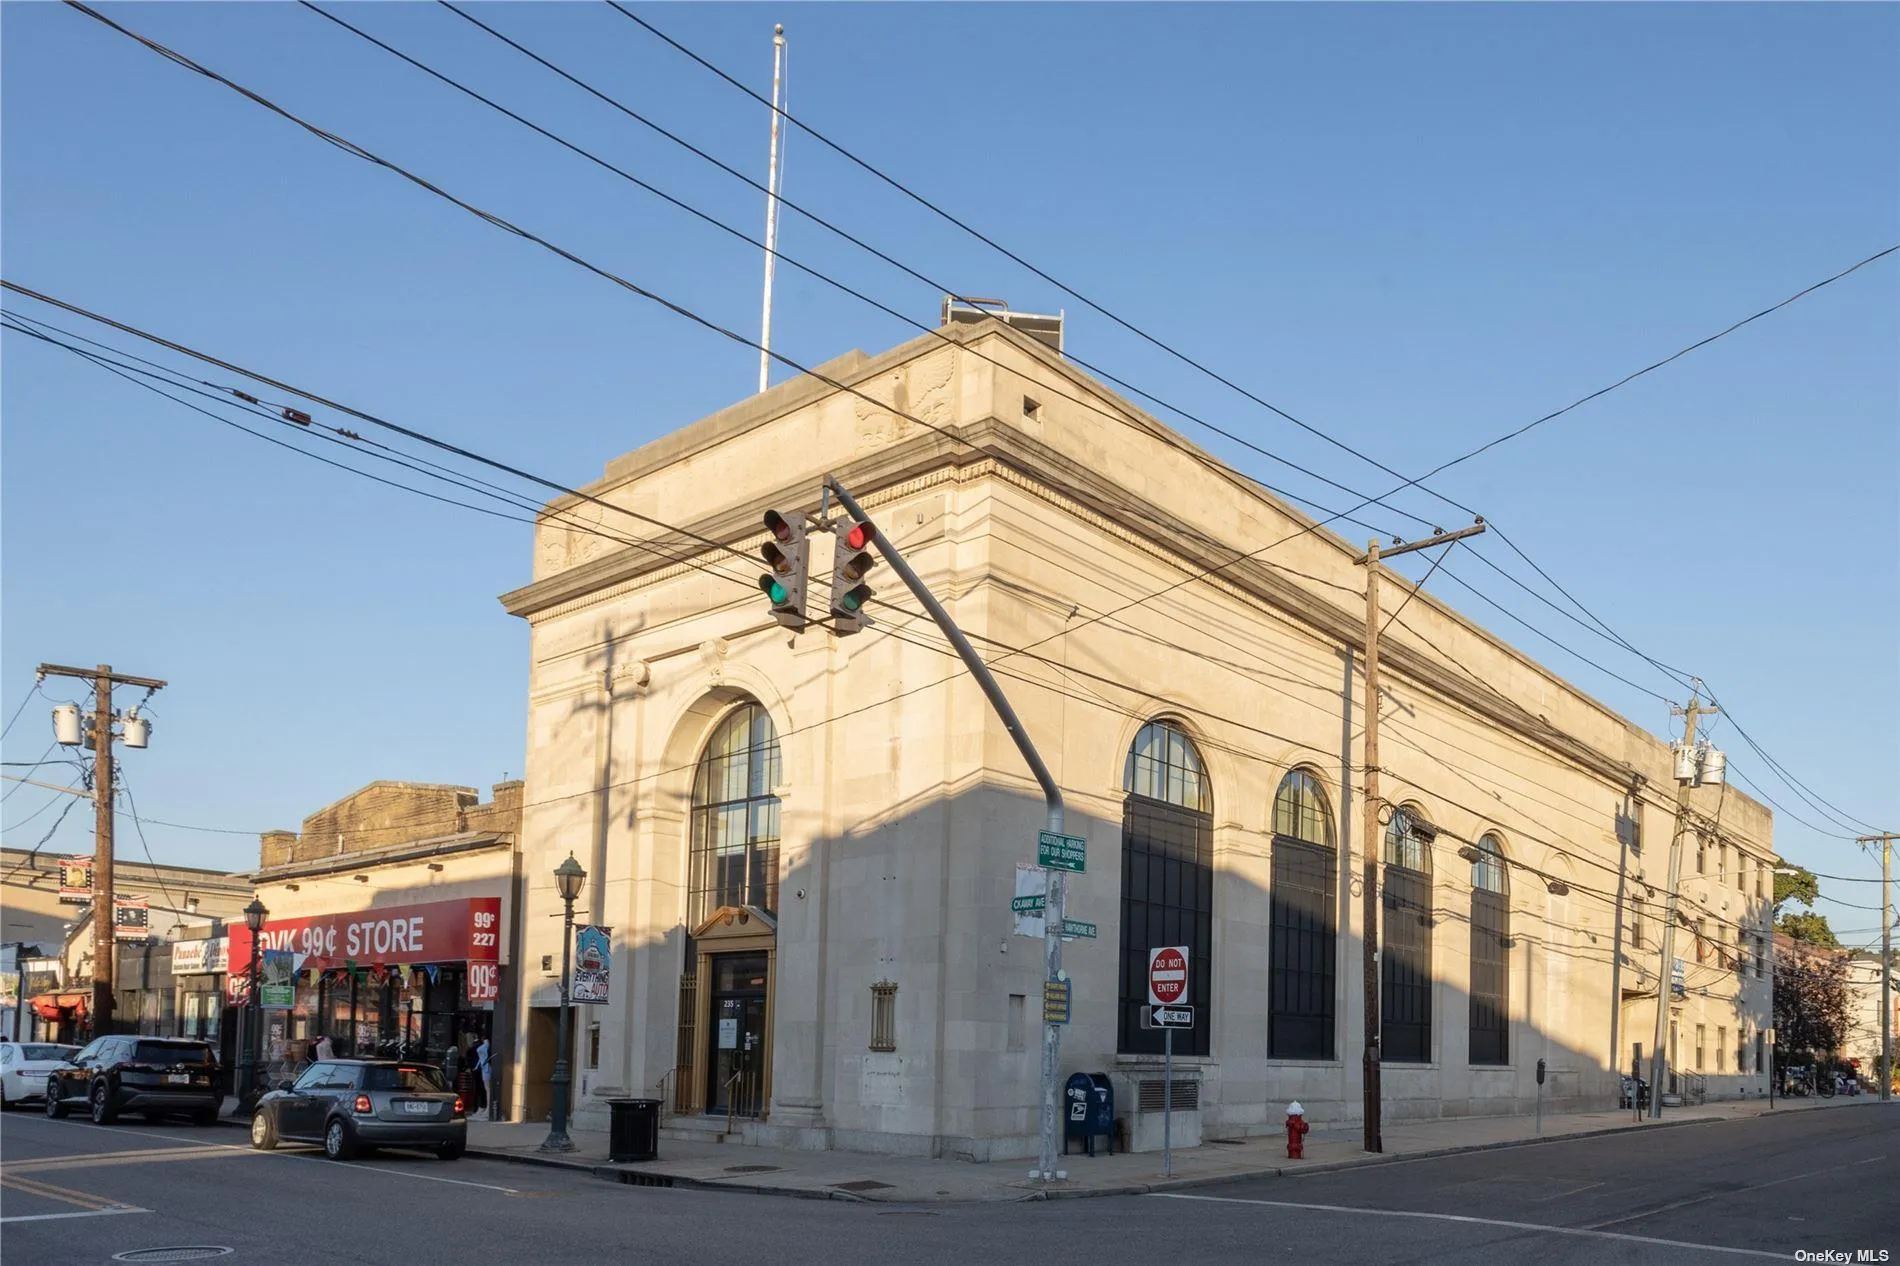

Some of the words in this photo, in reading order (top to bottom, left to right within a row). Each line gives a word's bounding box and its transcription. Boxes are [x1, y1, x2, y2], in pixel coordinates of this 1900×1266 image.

[1041, 833, 1066, 847] ADDITIONAL
[1040, 844, 1050, 855] FOR
[1050, 846, 1061, 857] OUR
[1061, 848, 1084, 862] SHOPPERS
[301, 925, 338, 957] 99¢
[346, 917, 424, 956] STORE
[472, 933, 495, 946] 227
[1155, 960, 1165, 968] DO
[1168, 959, 1182, 968] NOT
[576, 969, 609, 984] EVERYTHING
[488, 986, 498, 998] UP
[591, 983, 609, 997] AUTO
[1157, 983, 1179, 993] ENTER
[723, 1000, 734, 1008] 235
[1164, 1011, 1176, 1021] ONE
[1176, 1012, 1189, 1022] WAY
